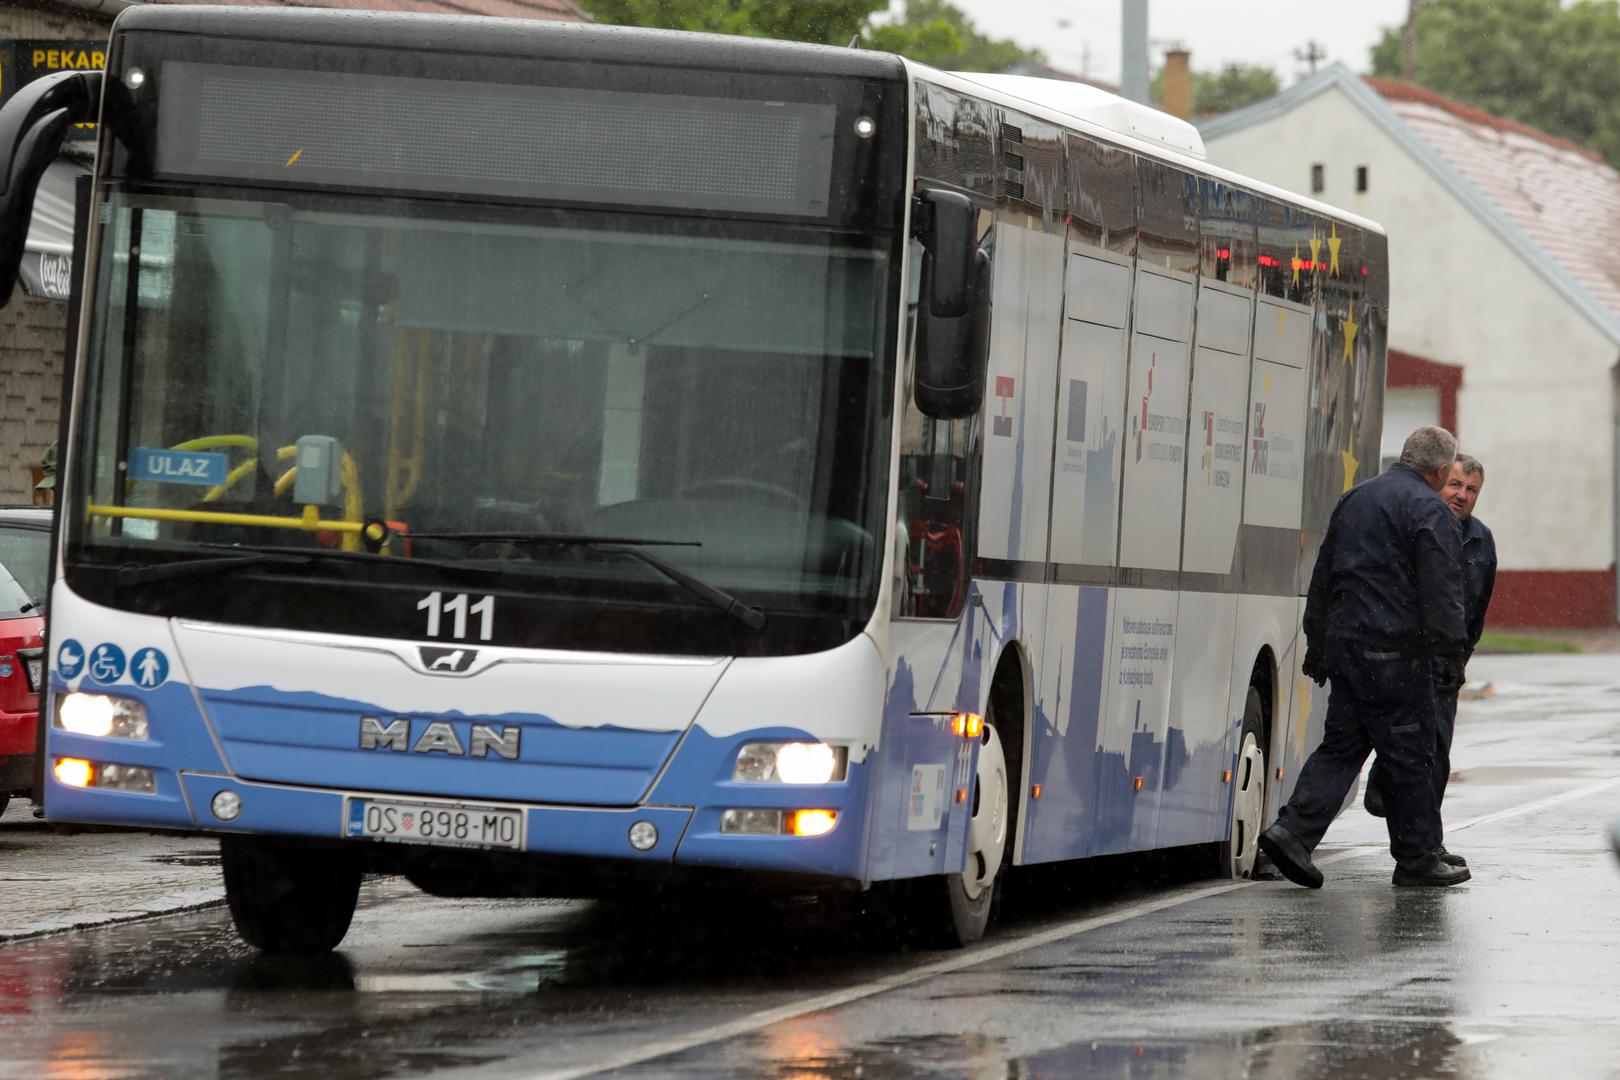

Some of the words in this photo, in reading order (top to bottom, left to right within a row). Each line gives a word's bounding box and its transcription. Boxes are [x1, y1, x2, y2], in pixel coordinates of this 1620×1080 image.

[148, 456, 210, 477] ULAZ
[417, 591, 495, 641] 111
[359, 714, 522, 760] MAN
[367, 806, 397, 834] OS
[419, 810, 515, 842] 898-MO
